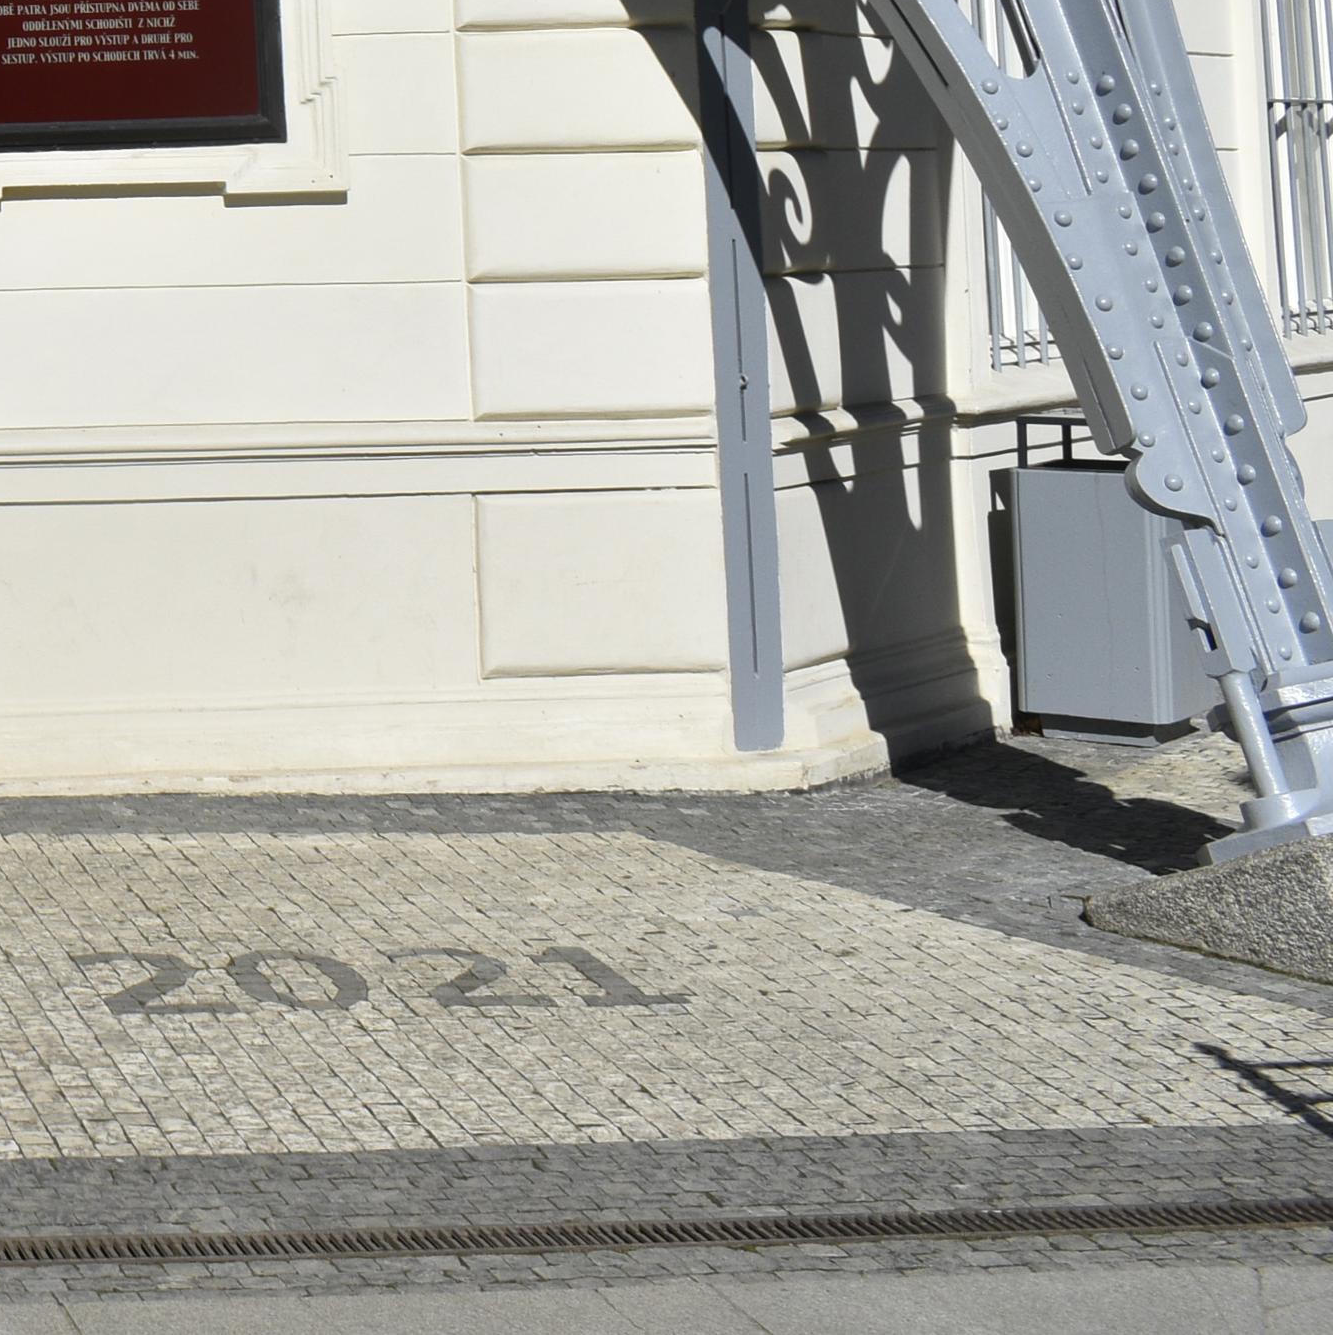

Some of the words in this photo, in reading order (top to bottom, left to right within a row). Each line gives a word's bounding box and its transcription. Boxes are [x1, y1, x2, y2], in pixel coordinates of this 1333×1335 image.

[17, 5, 47, 15] PATRA
[49, 4, 71, 16] JSOU
[128, 0, 161, 12] DVĚMA
[162, 1, 176, 11] OD
[177, 0, 200, 11] SEBE
[22, 18, 83, 31] ODDĚLENÝMI
[137, 18, 145, 28] Z
[146, 15, 176, 27] NICHŽ
[7, 37, 36, 49] JEDNO
[38, 34, 72, 47] SLOUŽÍ
[74, 35, 93, 46] PRO
[95, 32, 130, 45] VÝSTUP
[132, 34, 139, 44] A
[141, 31, 171, 44] DRUHÉ
[174, 33, 193, 43] PRO
[1, 53, 37, 64] SESTUP.
[40, 50, 75, 63] VÝSTUP
[78, 52, 90, 62] PO
[92, 51, 140, 62] SCHODECH
[143, 47, 167, 60] TRVÁ
[168, 50, 175, 60] 4
[70, 946, 696, 1016] 2021
